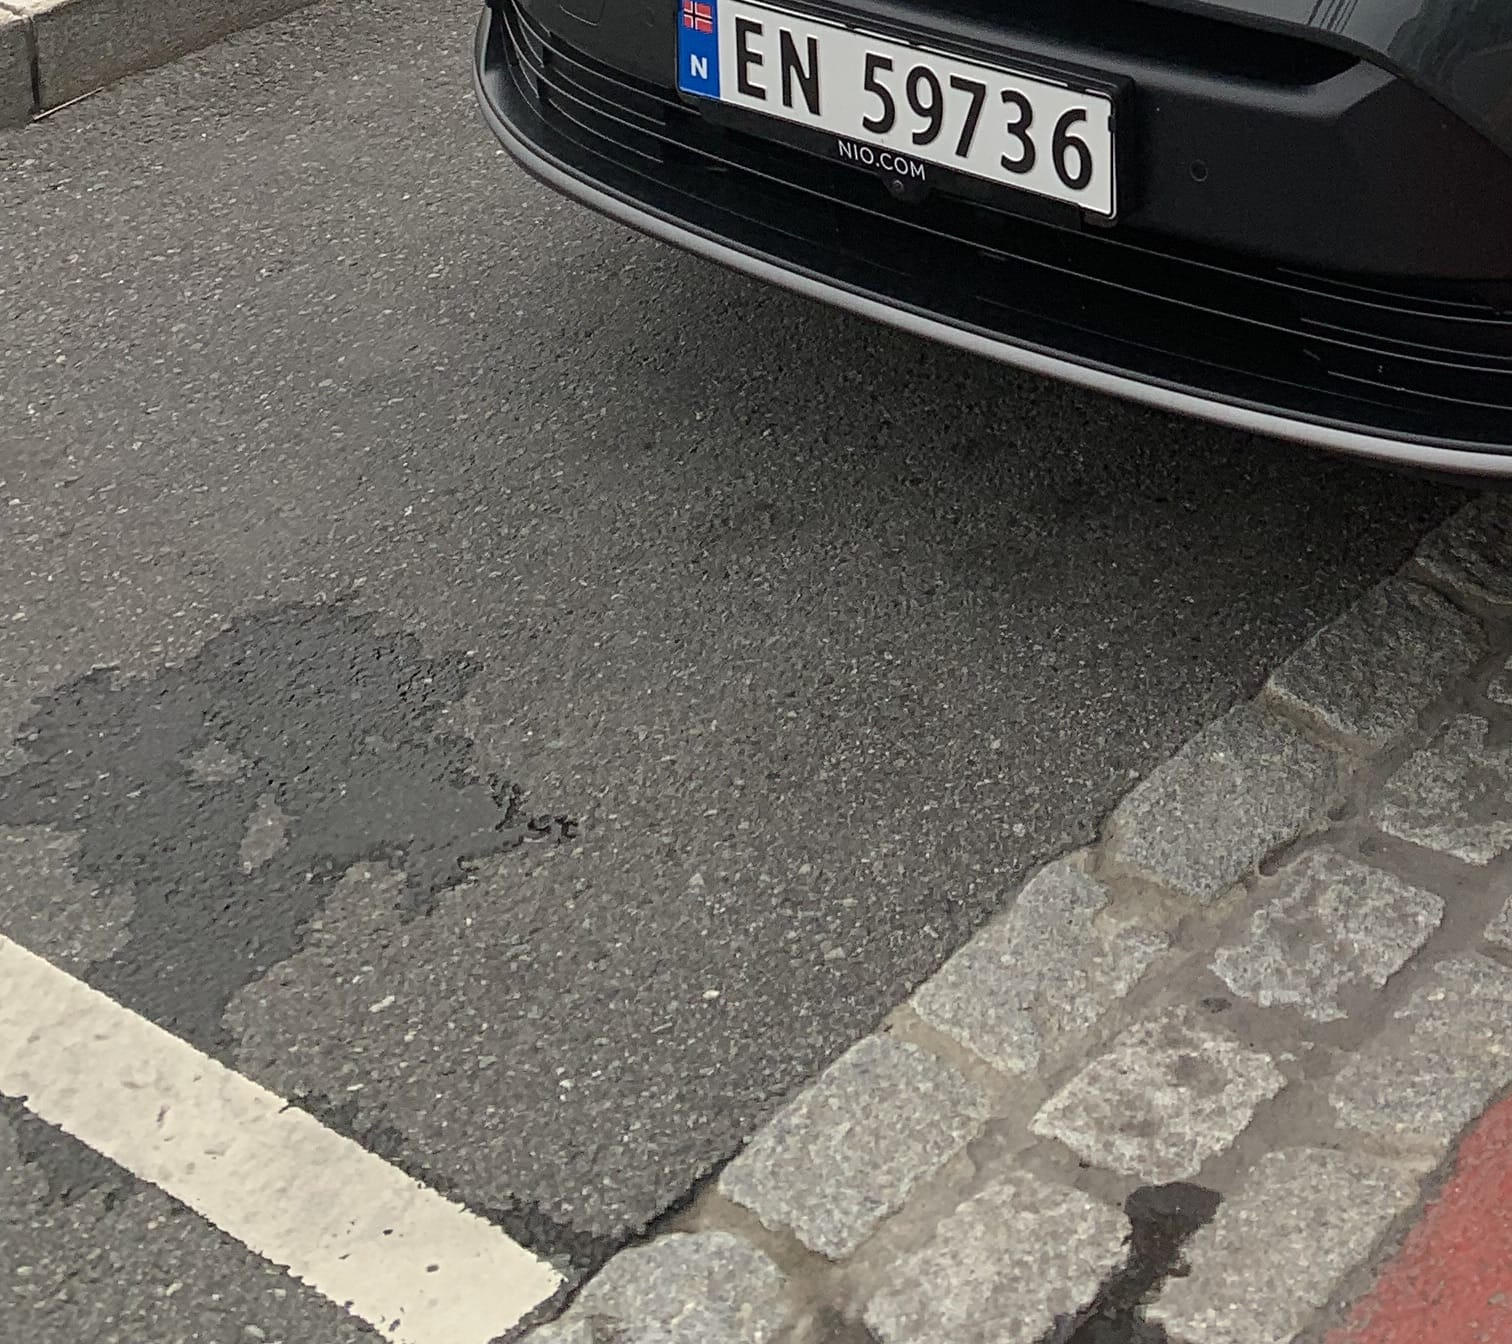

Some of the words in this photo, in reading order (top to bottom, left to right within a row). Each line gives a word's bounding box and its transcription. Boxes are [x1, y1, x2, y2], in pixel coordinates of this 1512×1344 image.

[690, 54, 708, 80] N
[735, 16, 820, 116] EN
[861, 51, 1094, 191] 59736
[837, 138, 926, 181] NIO.COM
